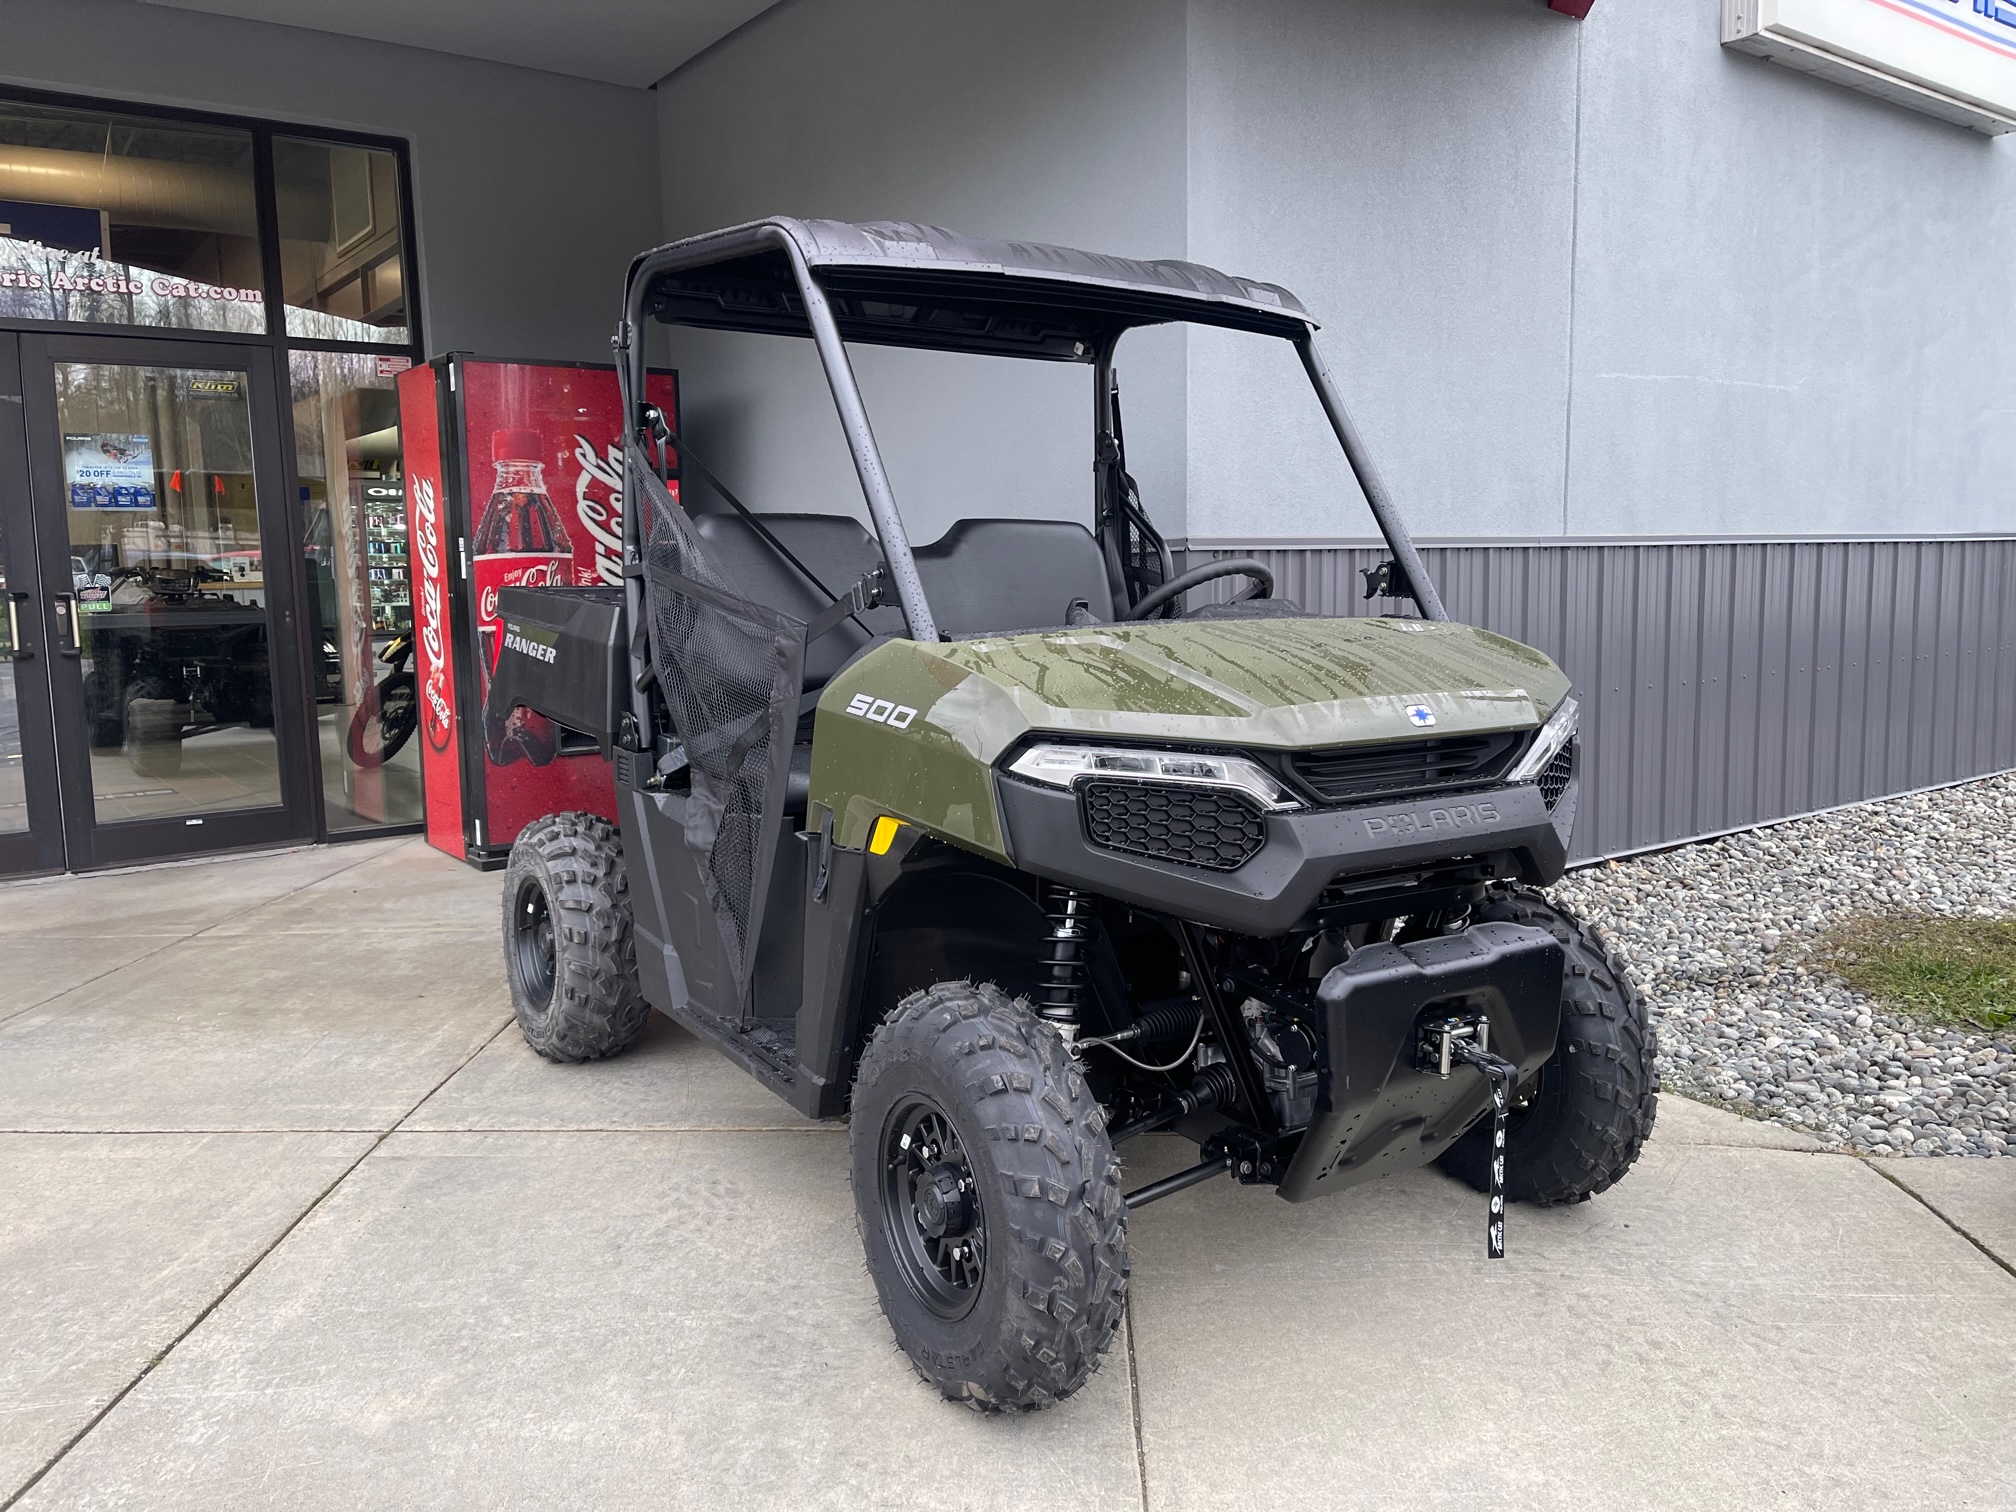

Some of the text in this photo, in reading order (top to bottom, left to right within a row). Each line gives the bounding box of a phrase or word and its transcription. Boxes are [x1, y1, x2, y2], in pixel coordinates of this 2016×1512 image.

[0, 239, 100, 263] nline at
[0, 269, 263, 303] ris Arctic Cat.com
[93, 469, 111, 478] OFF
[412, 472, 444, 669] Coca-Cola
[504, 568, 523, 582] Enjoy
[504, 632, 557, 664] RANGER
[845, 693, 918, 729] 500
[1362, 802, 1501, 839] POLARIS
